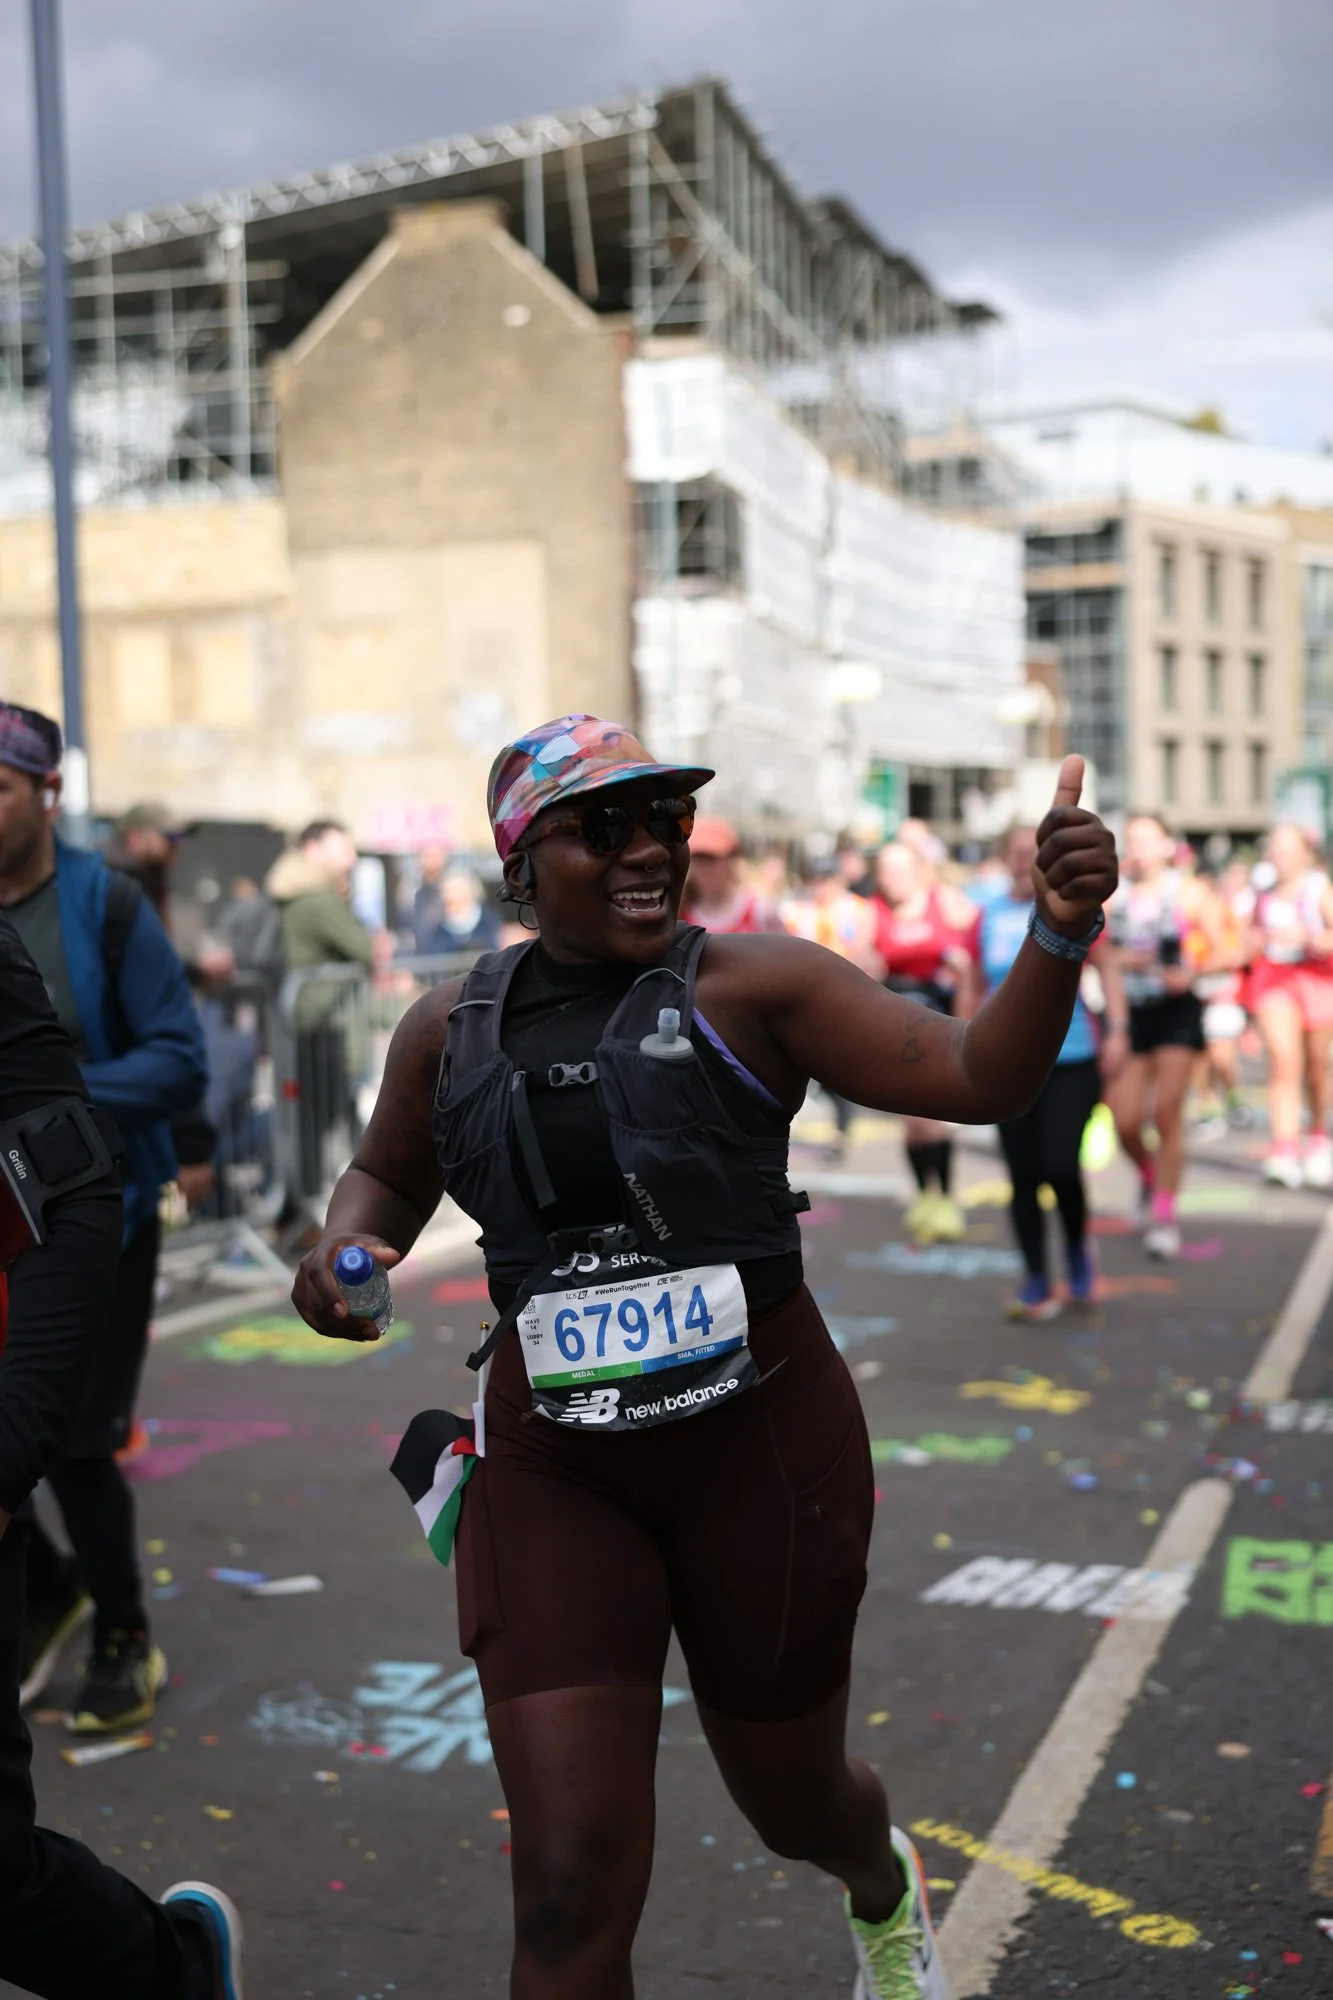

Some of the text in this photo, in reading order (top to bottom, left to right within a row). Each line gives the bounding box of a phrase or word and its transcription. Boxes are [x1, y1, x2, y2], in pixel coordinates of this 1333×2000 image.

[8, 1149, 27, 1180] Gritin
[623, 1172, 673, 1241] NATHAN
[595, 1281, 650, 1296] #WeRunTogether
[554, 1284, 714, 1362] 67914
[695, 1344, 716, 1355] FITTED
[571, 1370, 596, 1379] MEDAL
[624, 1377, 739, 1421] new balance
